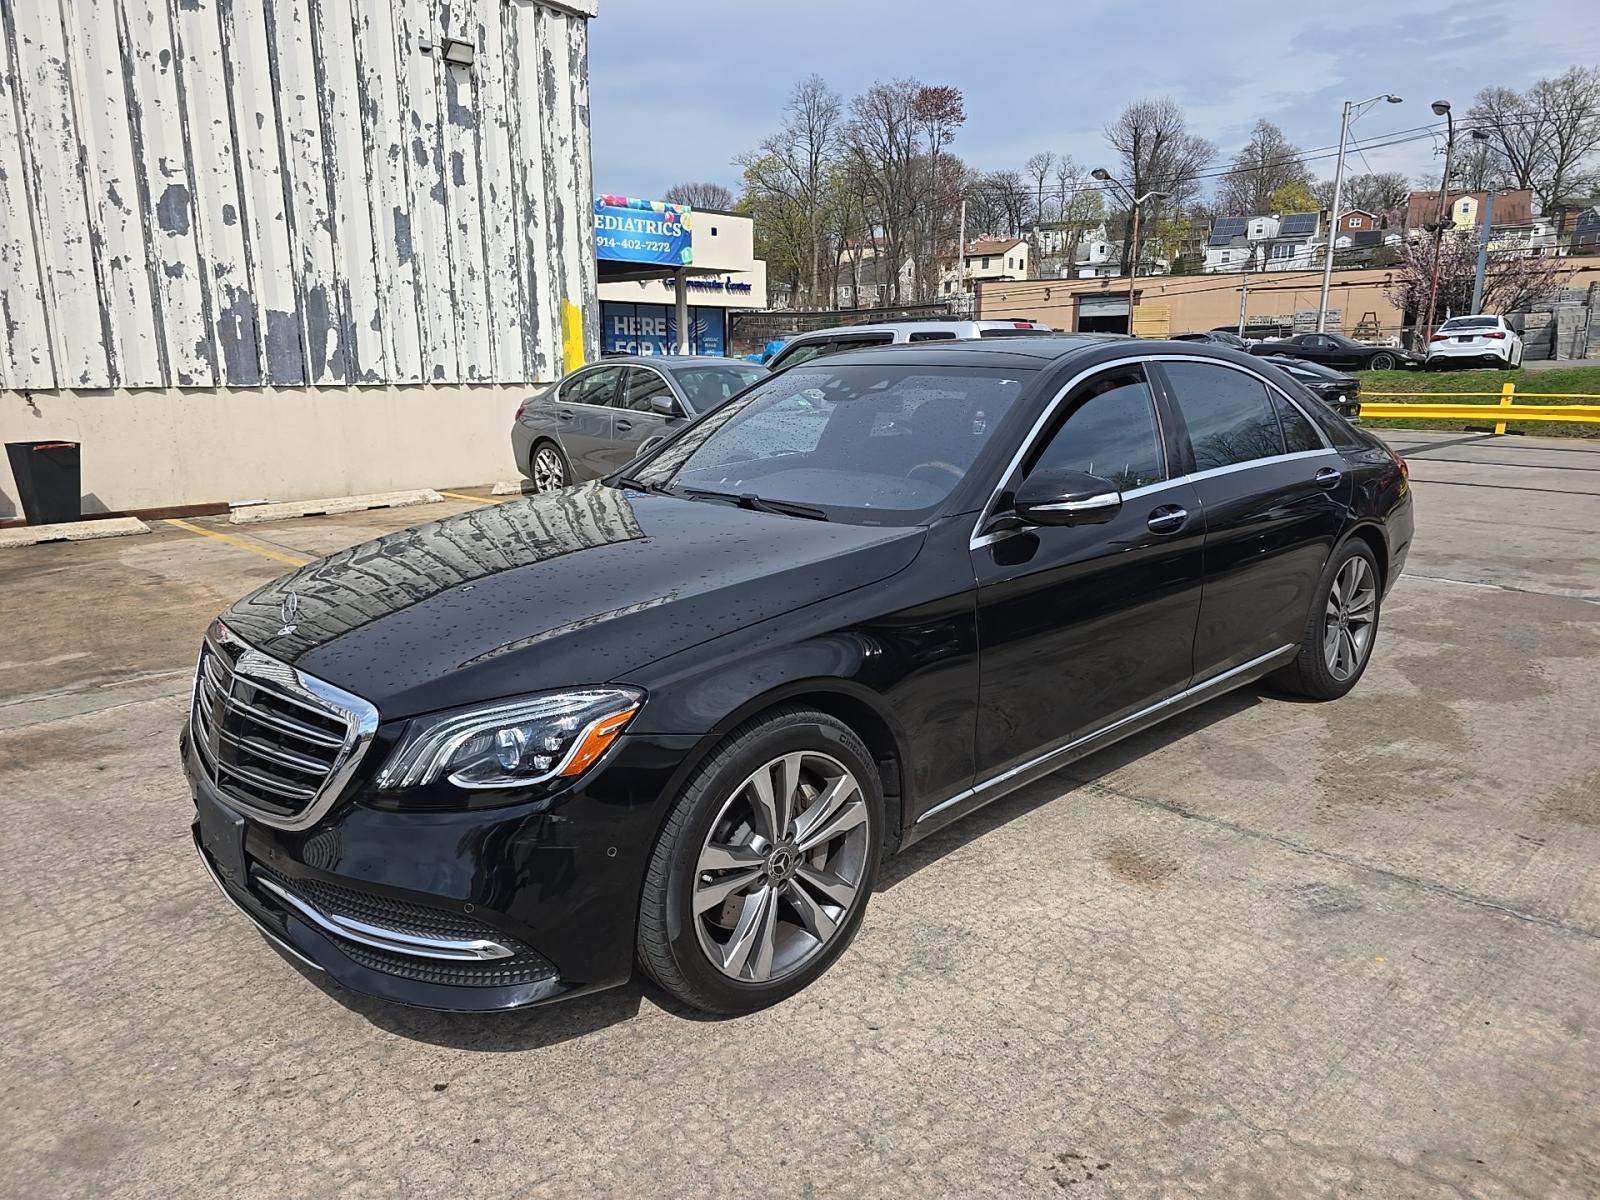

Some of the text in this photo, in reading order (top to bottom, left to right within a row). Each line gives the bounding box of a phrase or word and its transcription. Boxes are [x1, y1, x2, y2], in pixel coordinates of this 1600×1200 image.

[594, 214, 682, 237] EDIATRICS
[597, 236, 671, 253] 914-402-7272
[1044, 287, 1051, 301] 3
[614, 316, 667, 336] HERE
